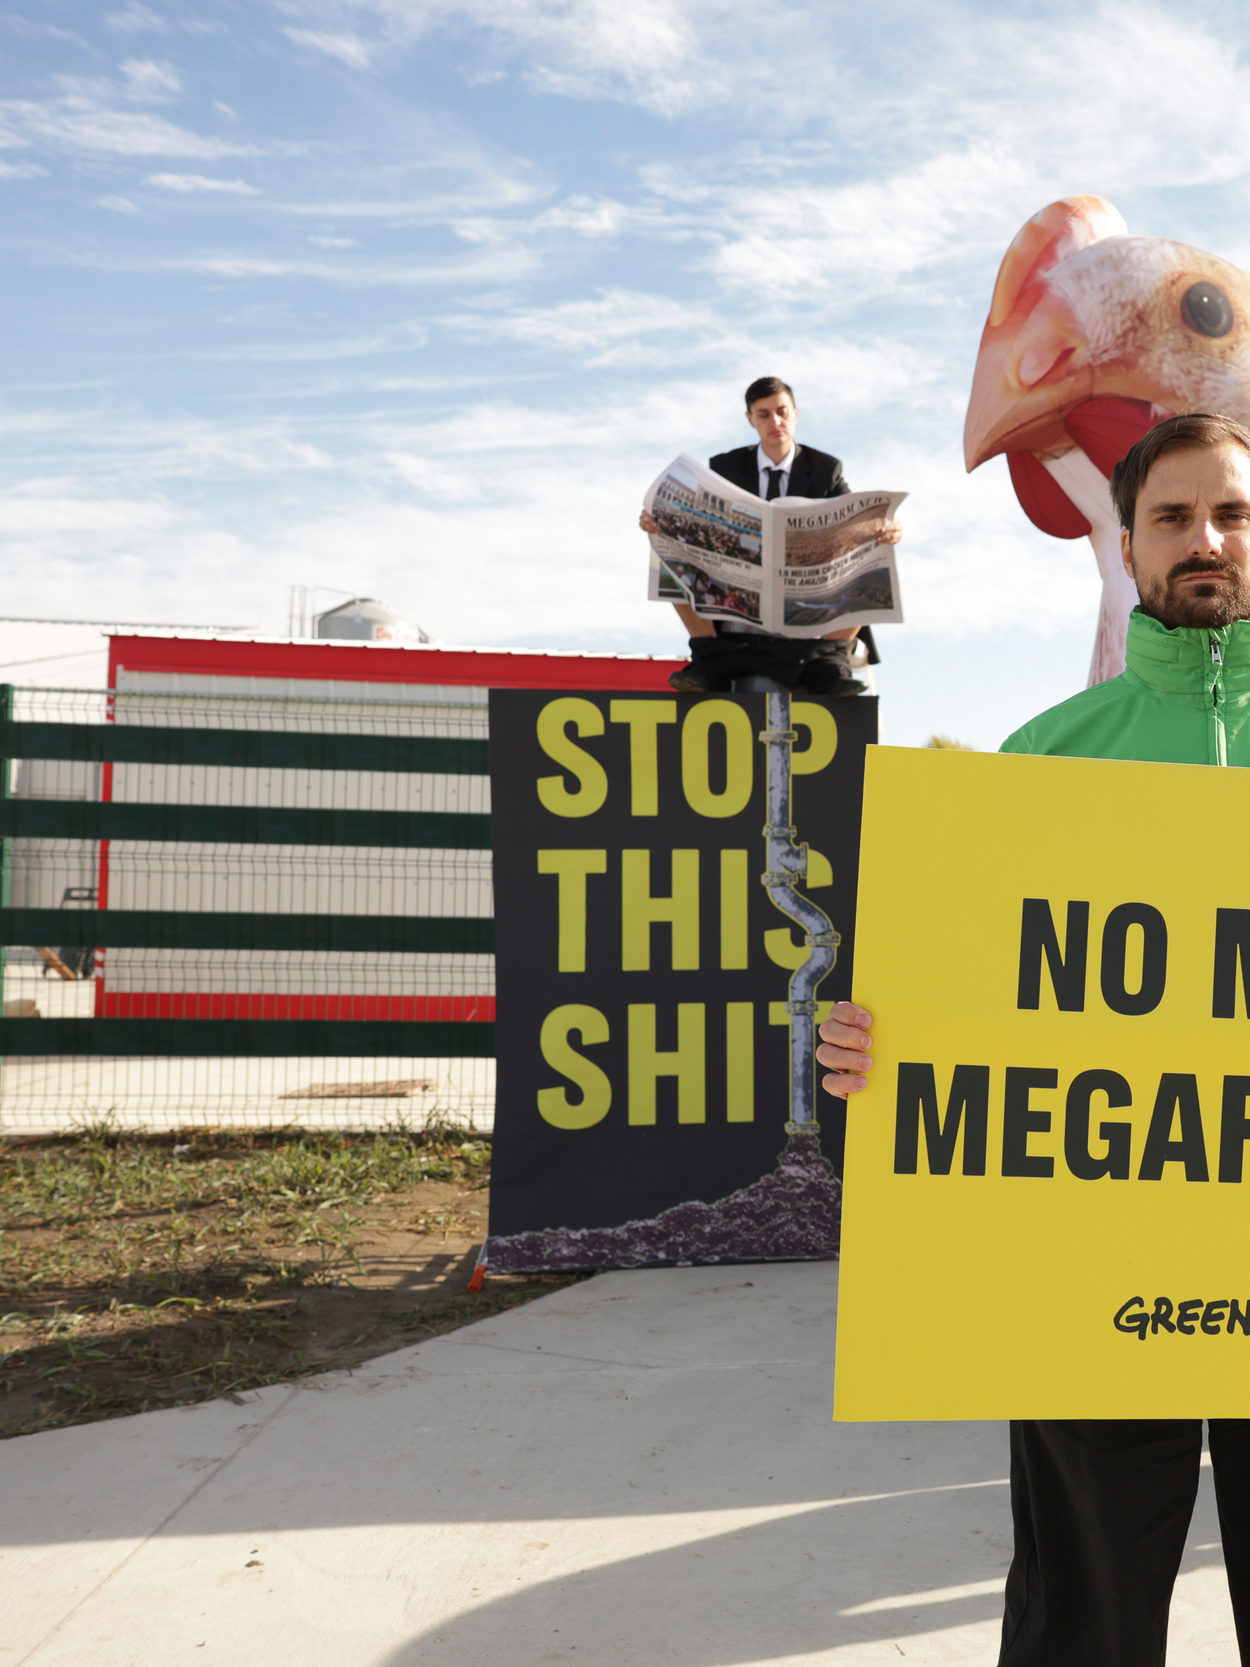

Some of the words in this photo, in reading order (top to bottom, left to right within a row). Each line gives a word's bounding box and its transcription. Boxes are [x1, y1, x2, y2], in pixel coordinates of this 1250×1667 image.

[786, 502, 855, 529] MEGAFARM
[858, 496, 892, 509] NEWS
[791, 568, 820, 578] MILLION
[536, 697, 838, 818] STOP
[1016, 898, 1168, 1016] NO
